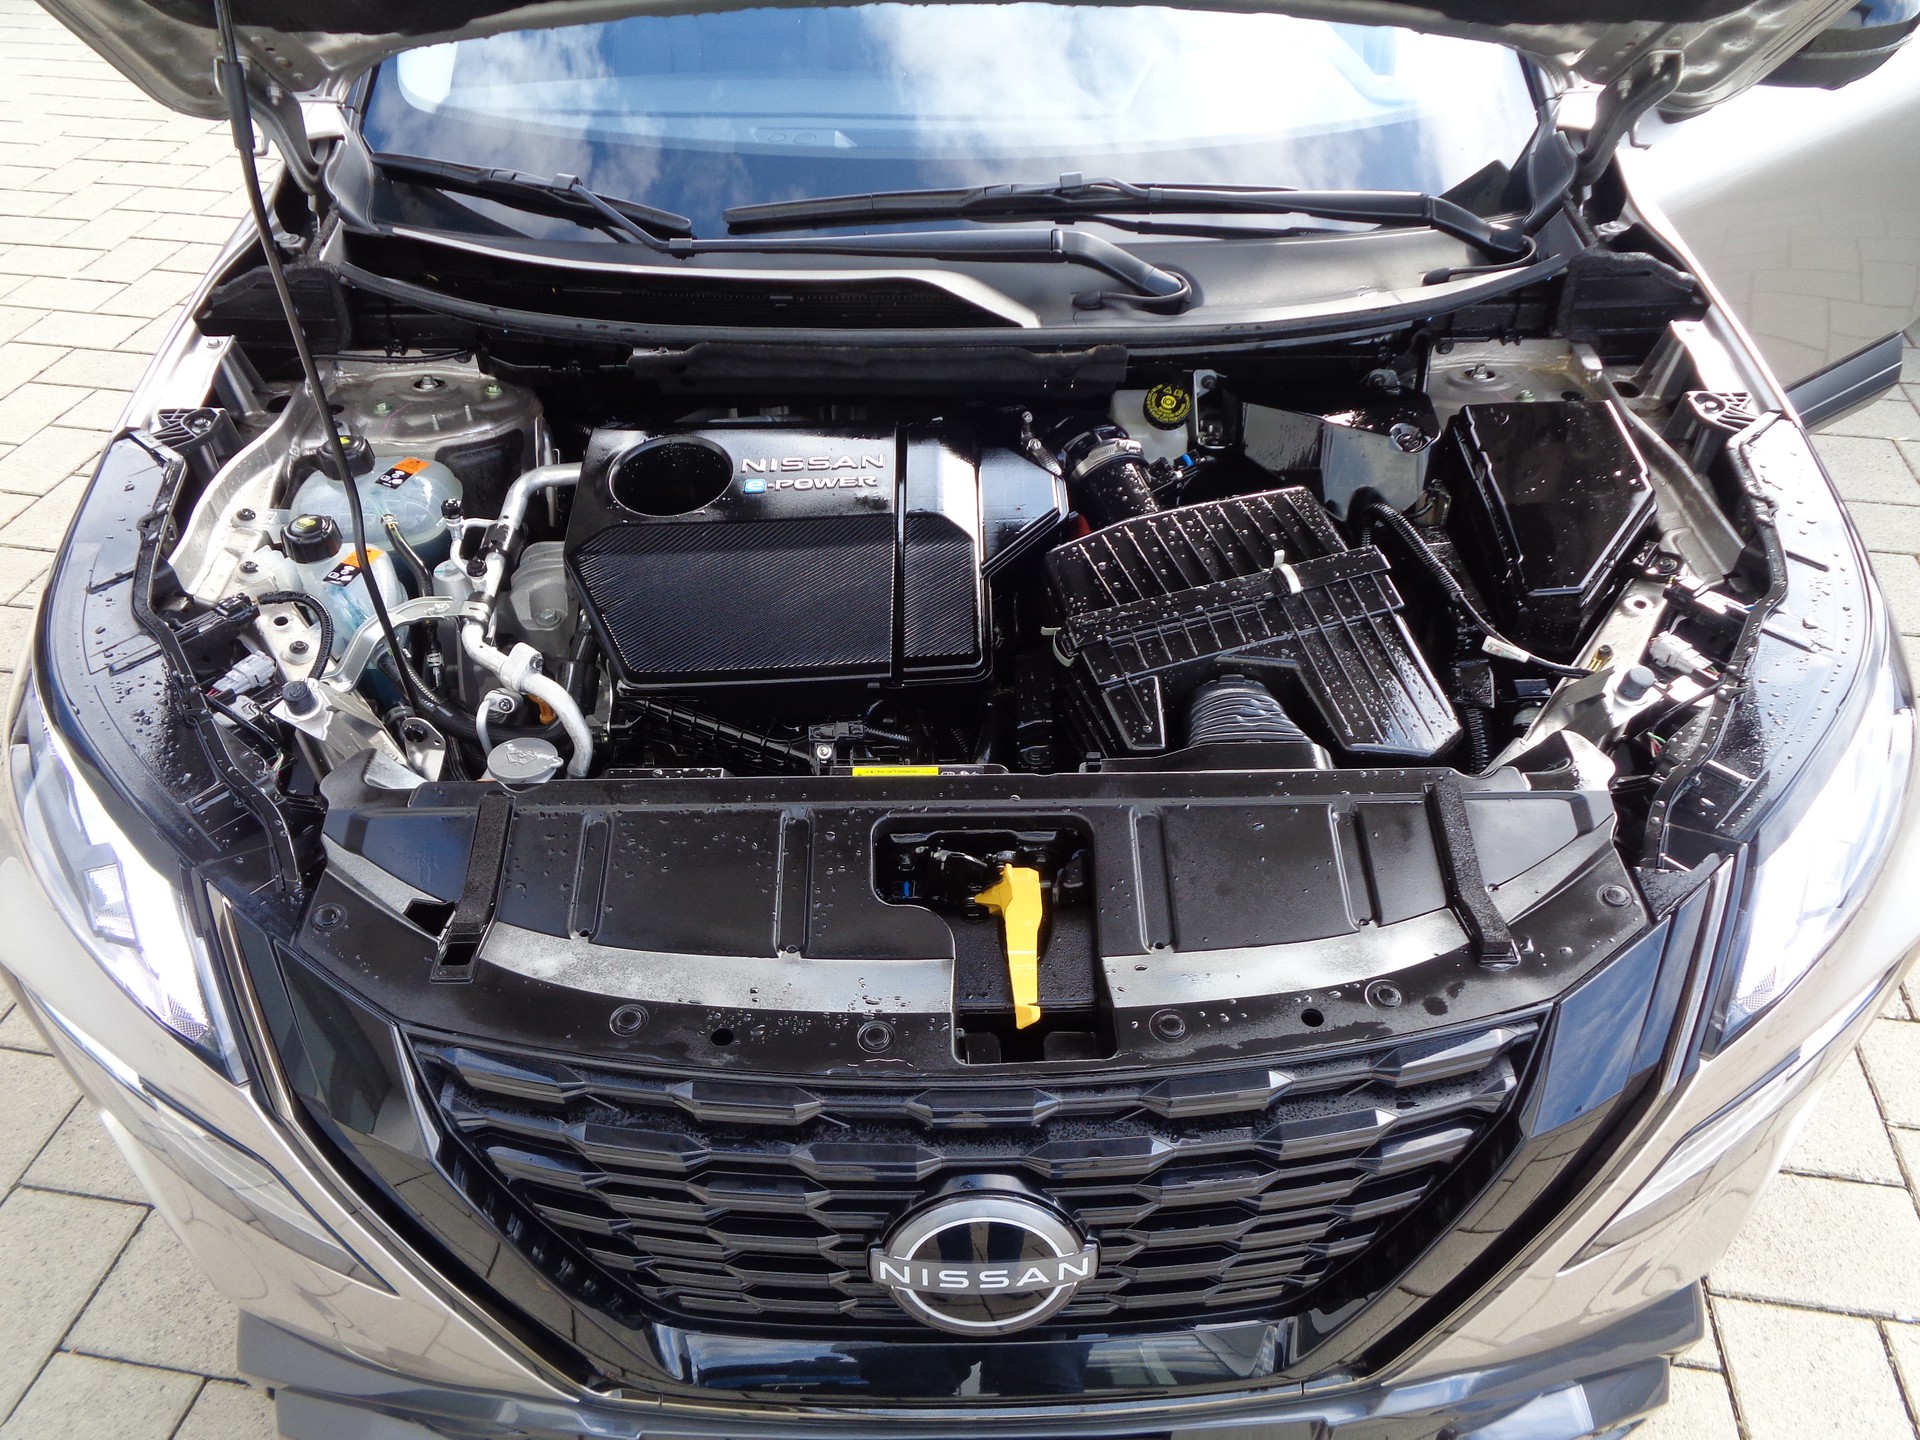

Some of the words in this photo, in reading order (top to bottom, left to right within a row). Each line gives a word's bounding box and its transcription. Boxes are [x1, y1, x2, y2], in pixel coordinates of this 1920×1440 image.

[741, 454, 885, 473] NISSAN
[744, 475, 878, 494] e-POWER
[879, 1257, 1089, 1289] NISSAN
